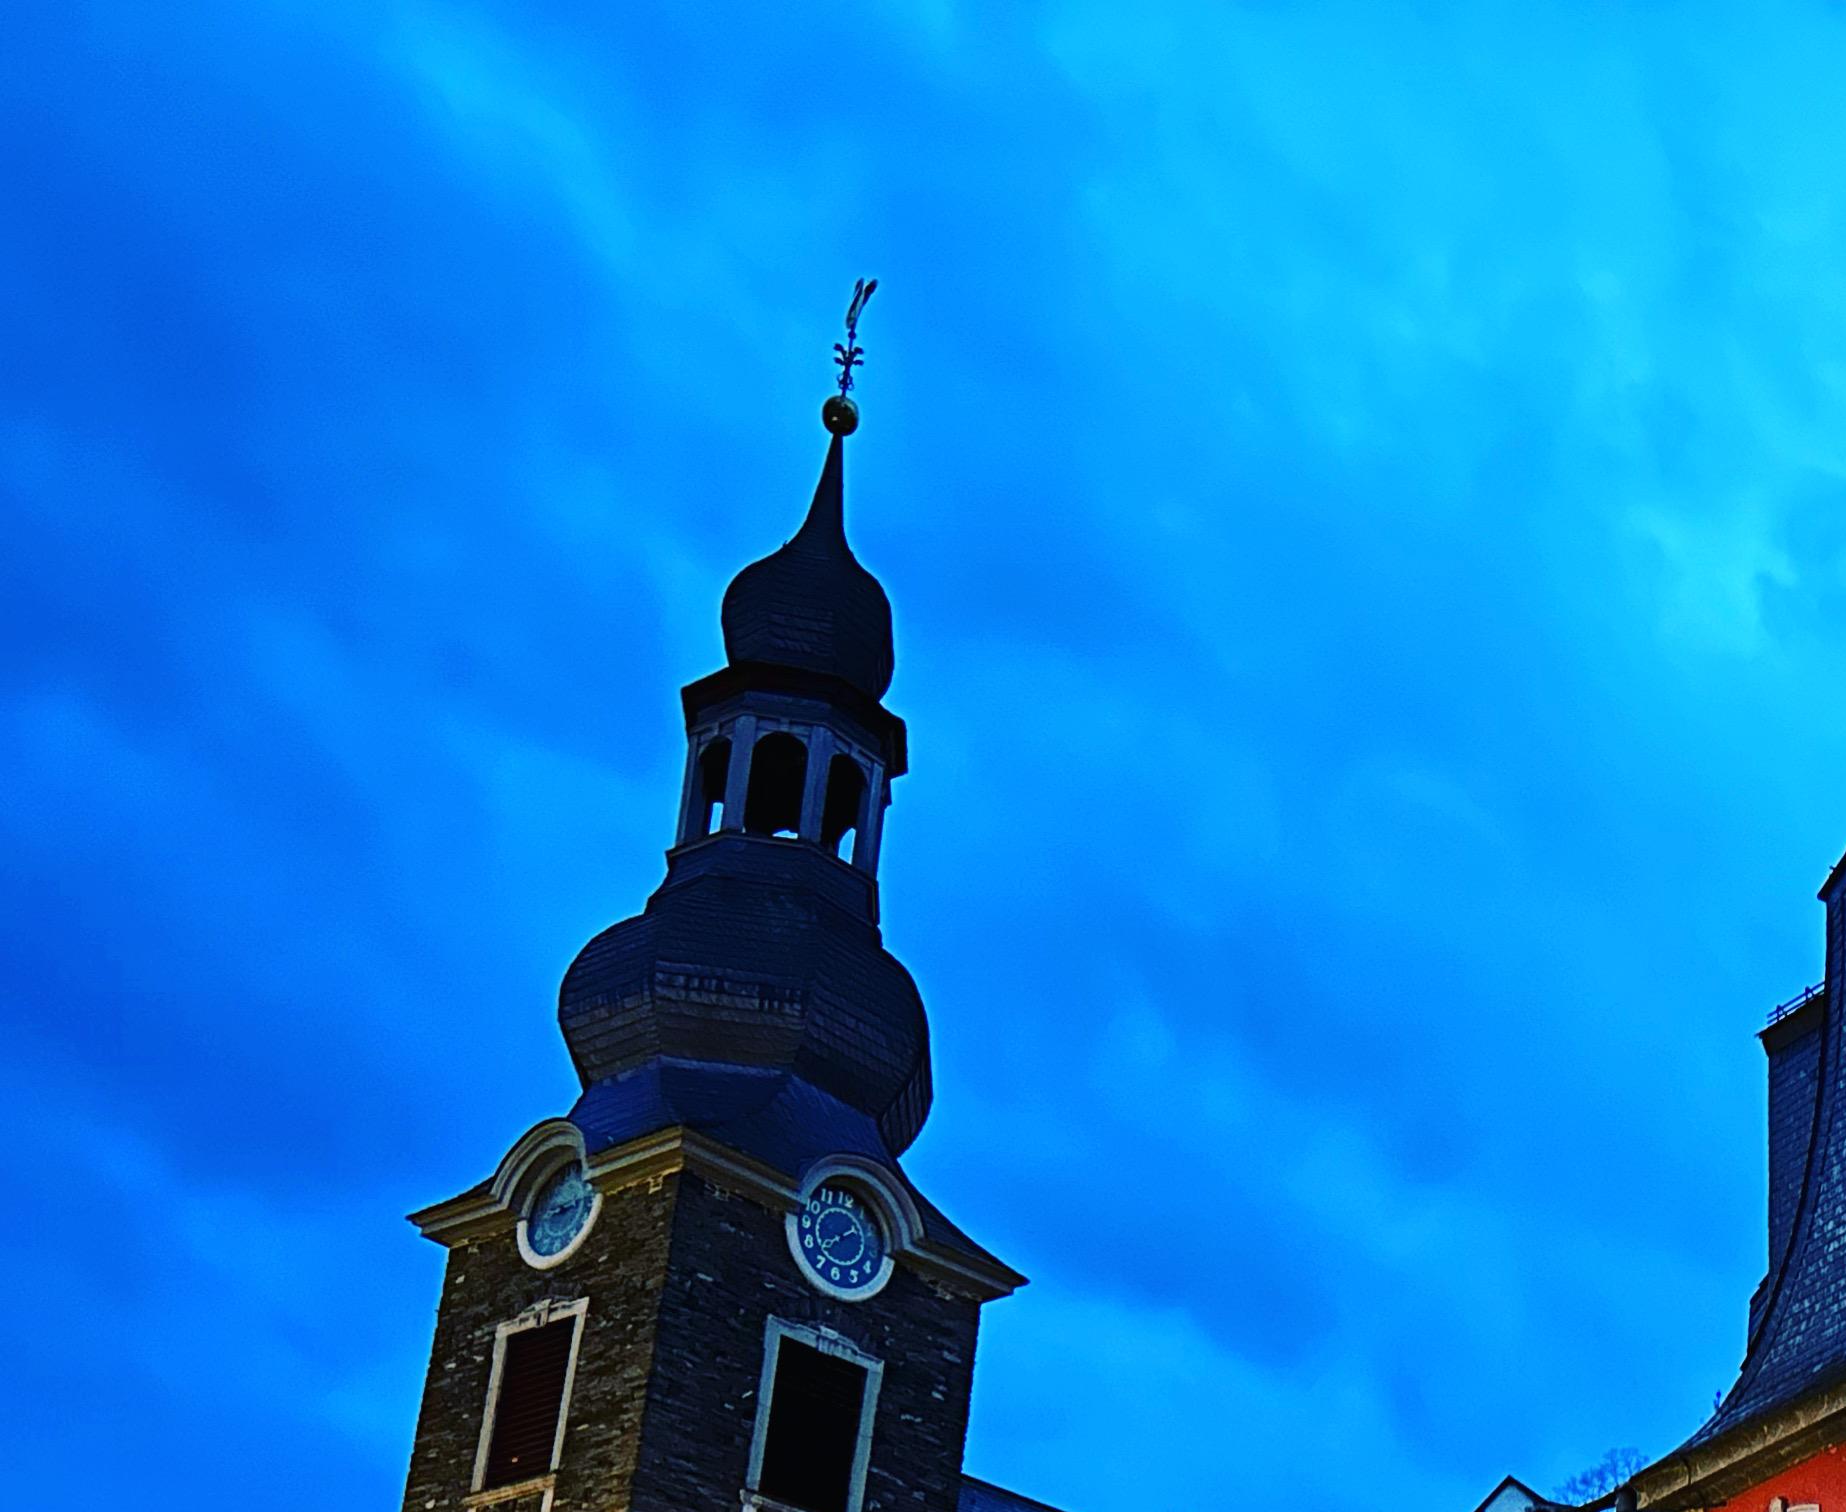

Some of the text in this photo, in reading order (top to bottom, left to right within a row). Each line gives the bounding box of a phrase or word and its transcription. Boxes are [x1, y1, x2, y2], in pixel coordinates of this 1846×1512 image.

[821, 1188, 833, 1205] 11
[837, 1191, 854, 1207] 12
[805, 1198, 820, 1214] 10
[801, 1216, 811, 1228] 9
[804, 1234, 814, 1248] 8
[815, 1255, 826, 1269] 7
[862, 1260, 872, 1274] 4
[830, 1267, 841, 1281] 6
